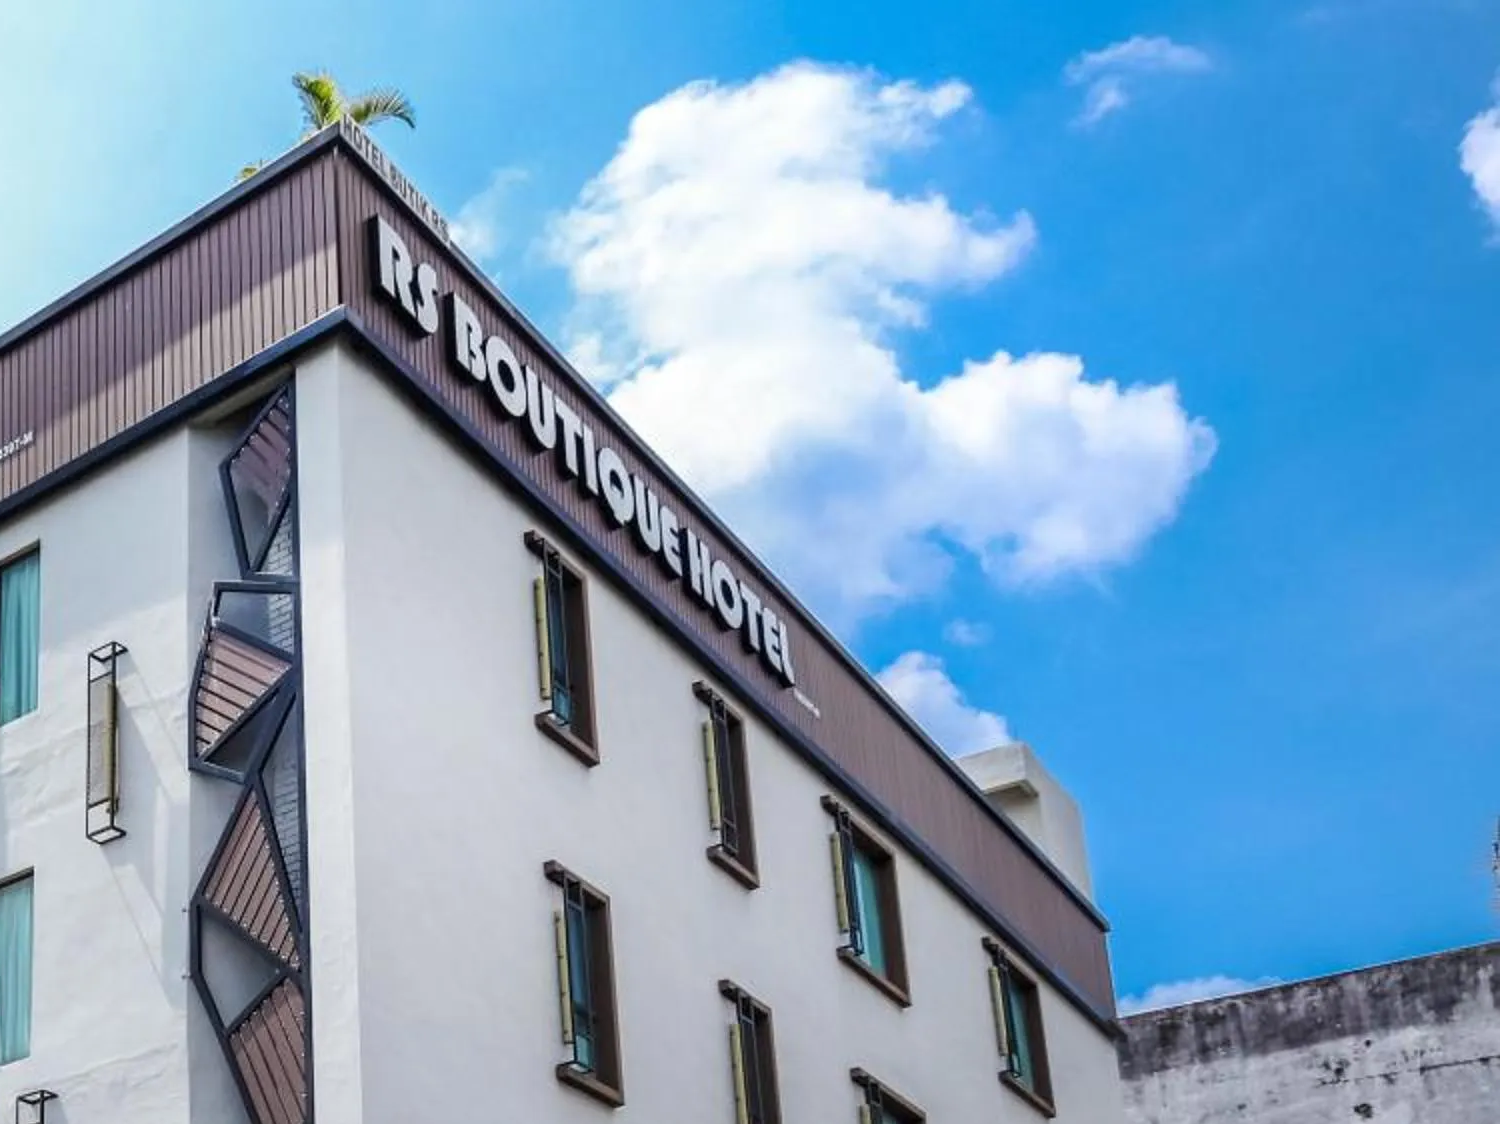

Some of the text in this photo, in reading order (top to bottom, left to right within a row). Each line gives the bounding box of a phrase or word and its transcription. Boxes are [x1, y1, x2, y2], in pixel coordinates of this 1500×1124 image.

[378, 214, 795, 685] RS BOUTIQUE HOTEL
